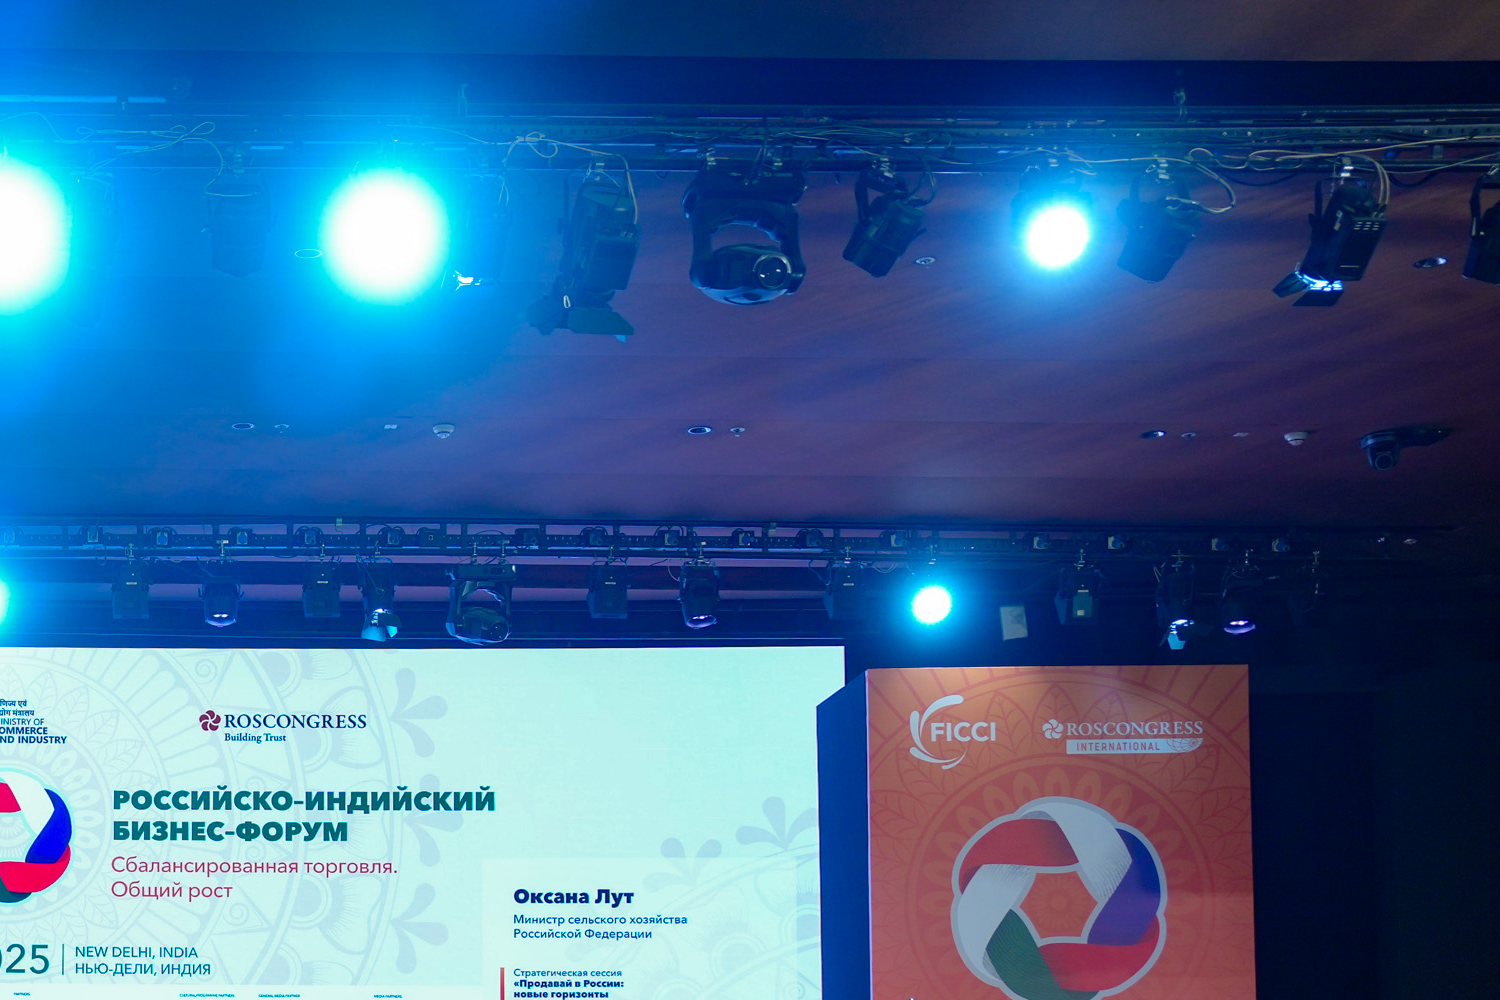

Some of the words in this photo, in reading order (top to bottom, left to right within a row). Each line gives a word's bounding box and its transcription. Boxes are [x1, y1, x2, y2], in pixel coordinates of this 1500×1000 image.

[224, 714, 367, 730] ROSCONGRESS
[1066, 720, 1203, 736] ROSCONGRESS
[224, 732, 262, 744] Building
[264, 733, 287, 742] Trust
[931, 721, 995, 742] FICCI
[18, 736, 67, 744] INDUSTRY
[1076, 741, 1160, 752] INTERNATIONAL
[113, 785, 496, 814] РОССИЙСКО-ИНДИЙСКИЙ
[113, 821, 348, 842] БИЗНЕС-ФОРУМ
[112, 855, 298, 875] Сбалансированная
[304, 858, 397, 876] торговля.
[111, 881, 183, 899] Общий
[189, 883, 233, 901] рост
[514, 889, 590, 904] Оксана
[595, 889, 634, 908] Лут
[513, 914, 565, 926] Министр
[568, 915, 626, 925] сельского
[630, 914, 688, 925] хозяйства
[513, 928, 581, 939] Российской
[585, 928, 652, 941] Федерации
[75, 946, 107, 958] NEW
[112, 946, 156, 961] DELHI,
[159, 947, 198, 959] INDIA
[74, 962, 158, 976] НЬЮ-ДЕЛИ,
[161, 964, 211, 976] ИНДИЯ
[513, 968, 588, 978] Стратегическая
[591, 969, 622, 977] сессия
[514, 979, 572, 989] «Продавай
[583, 980, 624, 989] России:
[551, 991, 609, 999] горизонты
